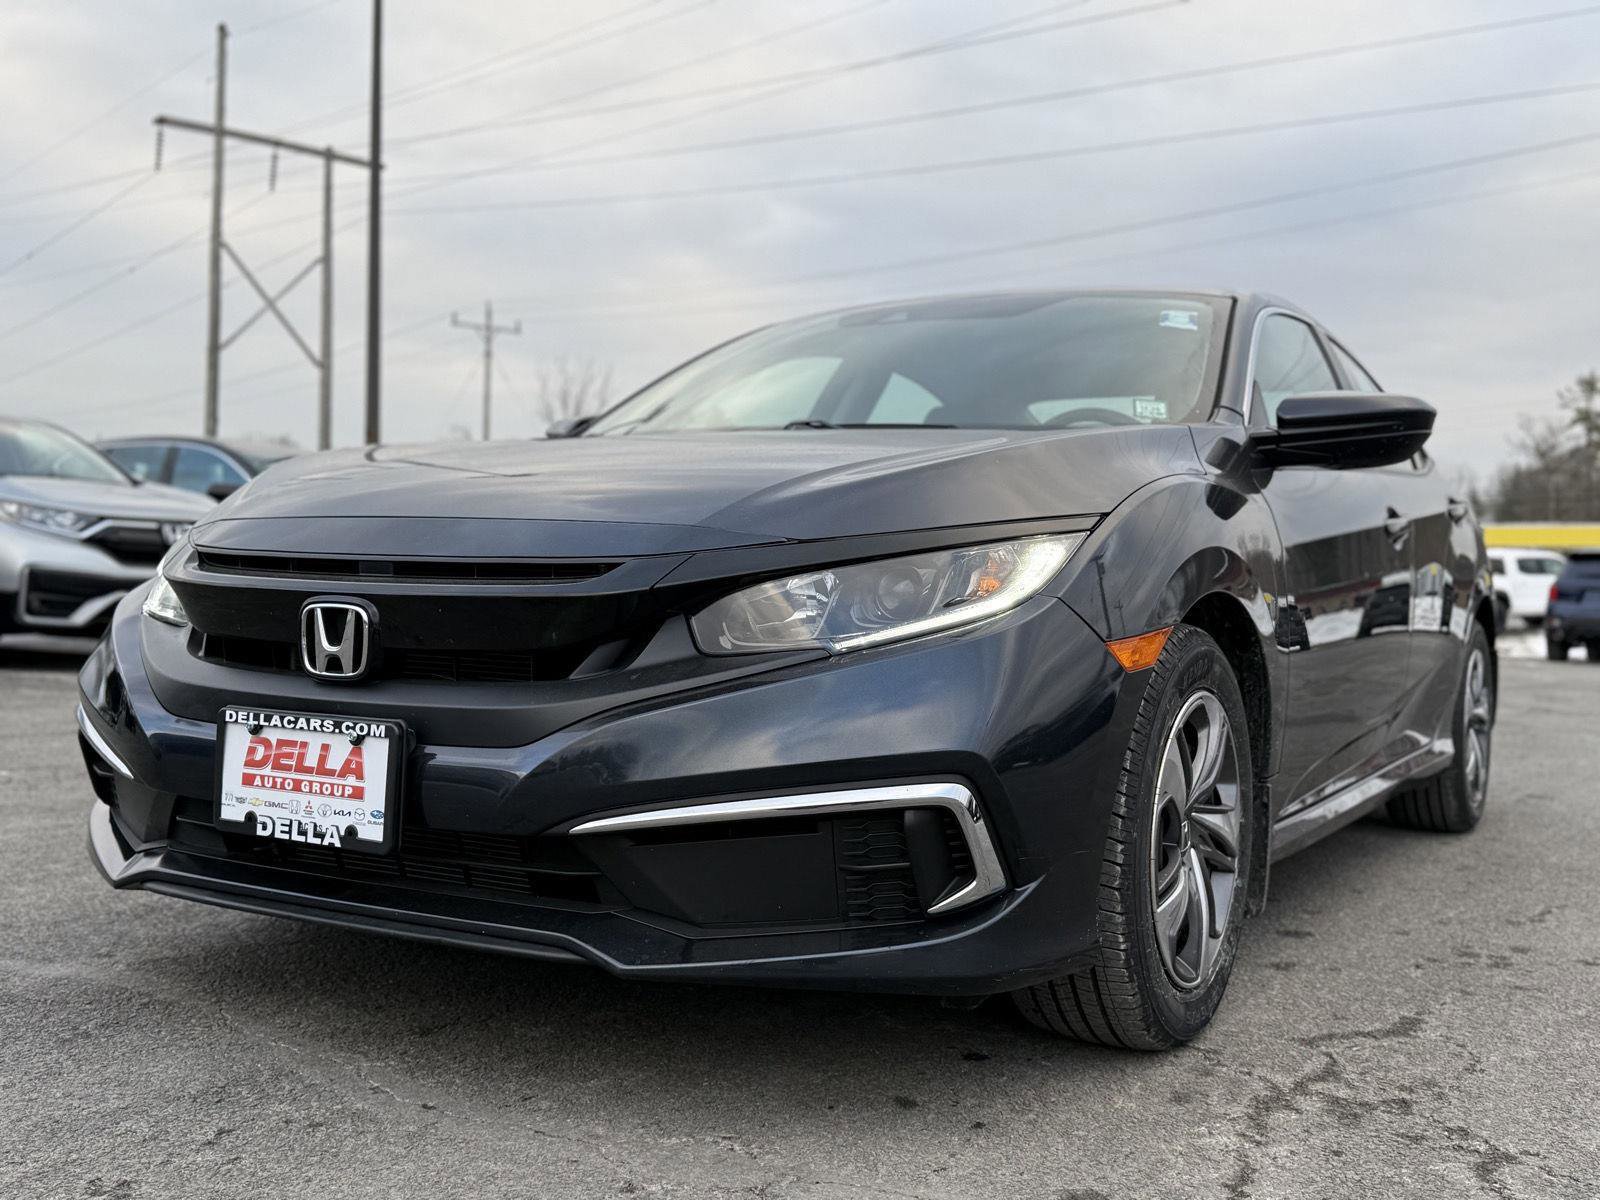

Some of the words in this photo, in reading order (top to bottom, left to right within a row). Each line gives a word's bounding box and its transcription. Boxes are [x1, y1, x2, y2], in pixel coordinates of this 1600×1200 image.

[225, 710, 386, 738] DELLACARS.COM
[243, 735, 366, 783] DELLA
[253, 775, 294, 790] AUTO
[301, 780, 353, 798] GROUP
[264, 801, 289, 809] GMC
[256, 815, 342, 848] DELLA
